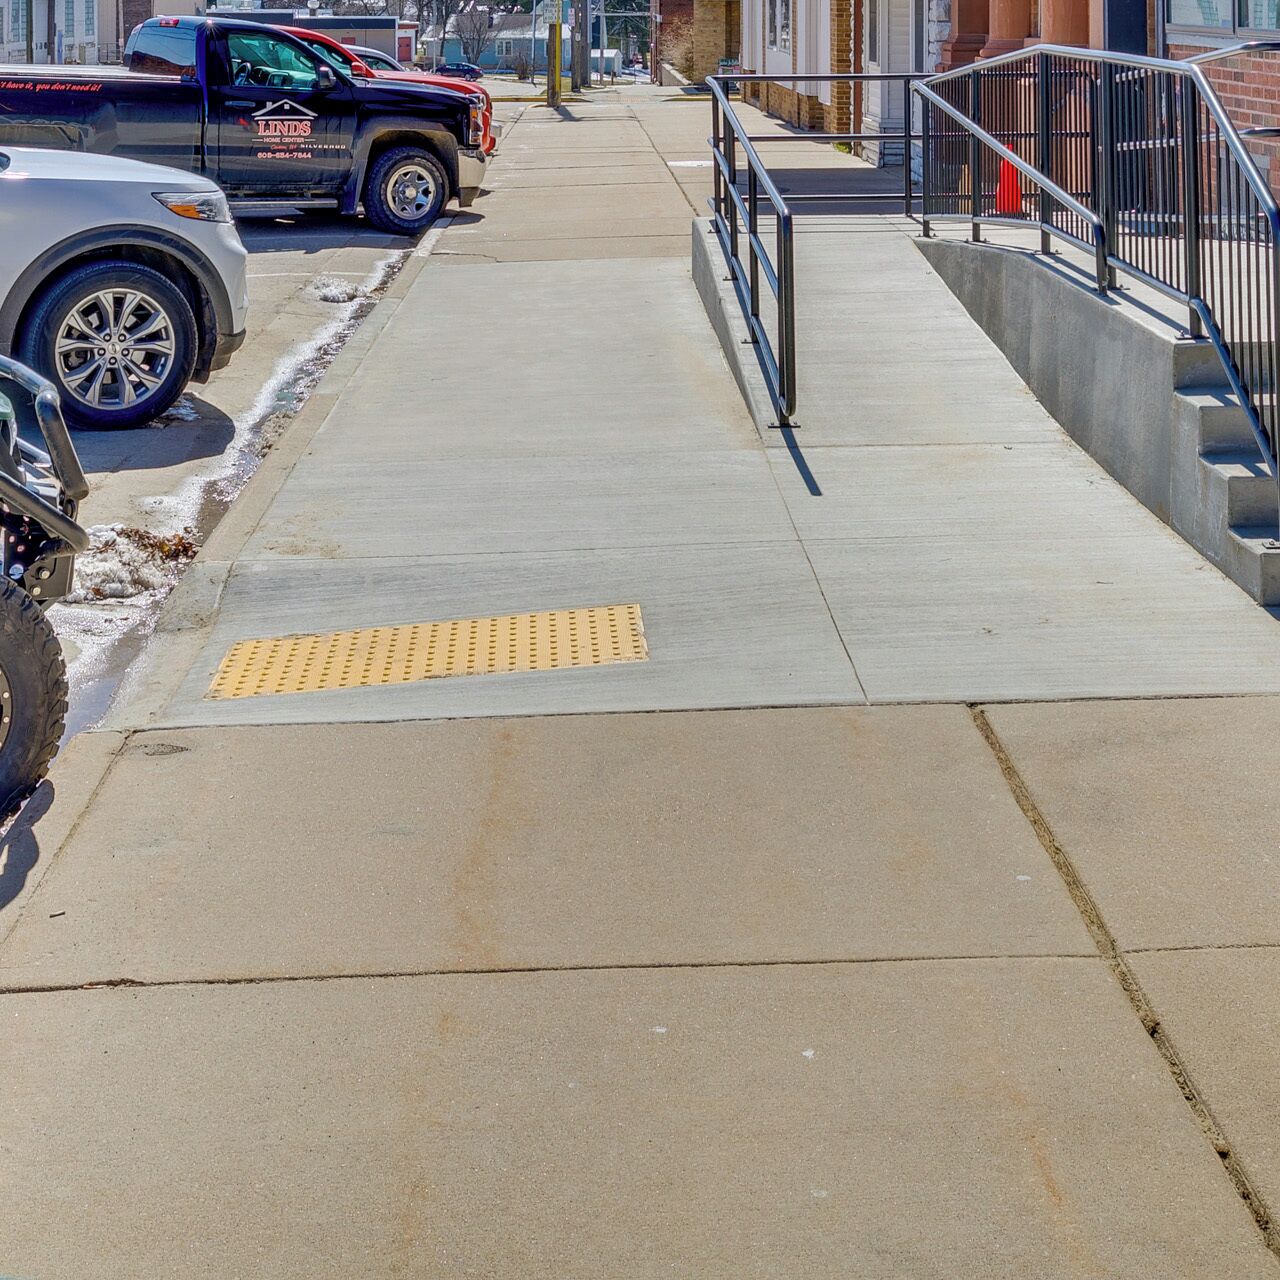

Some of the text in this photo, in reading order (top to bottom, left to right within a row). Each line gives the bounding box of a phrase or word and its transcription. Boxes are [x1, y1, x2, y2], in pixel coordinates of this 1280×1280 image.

[6, 81, 25, 89] have
[36, 83, 50, 92] you
[51, 82, 72, 90] don't
[71, 83, 91, 91] need
[257, 121, 311, 136] LINDS
